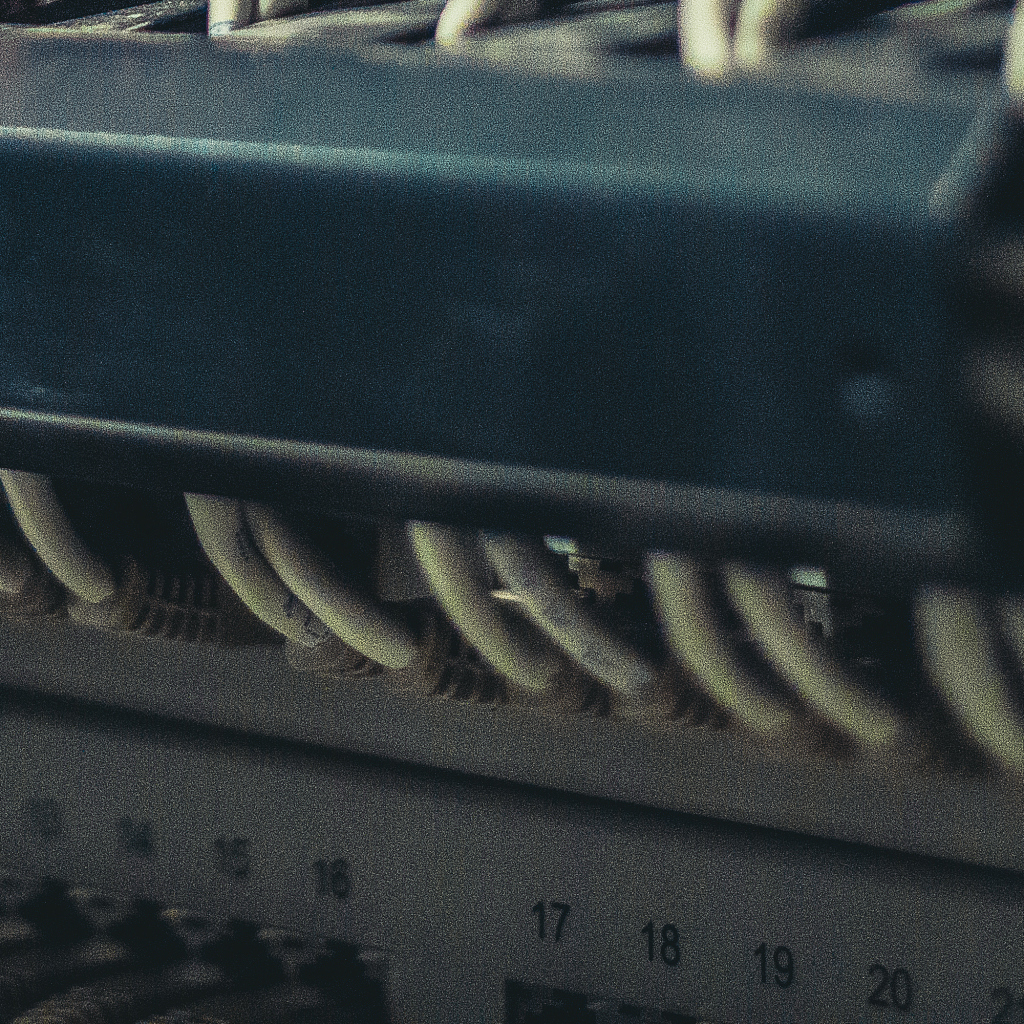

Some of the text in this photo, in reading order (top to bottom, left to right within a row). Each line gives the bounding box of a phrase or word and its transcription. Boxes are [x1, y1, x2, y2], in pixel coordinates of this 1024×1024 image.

[213, 836, 252, 880] 15
[312, 857, 352, 901] 16
[531, 900, 571, 942] 17
[641, 920, 681, 968] 18
[753, 942, 796, 990] 19
[866, 963, 915, 1014] 20
[990, 986, 1024, 1024] 2
